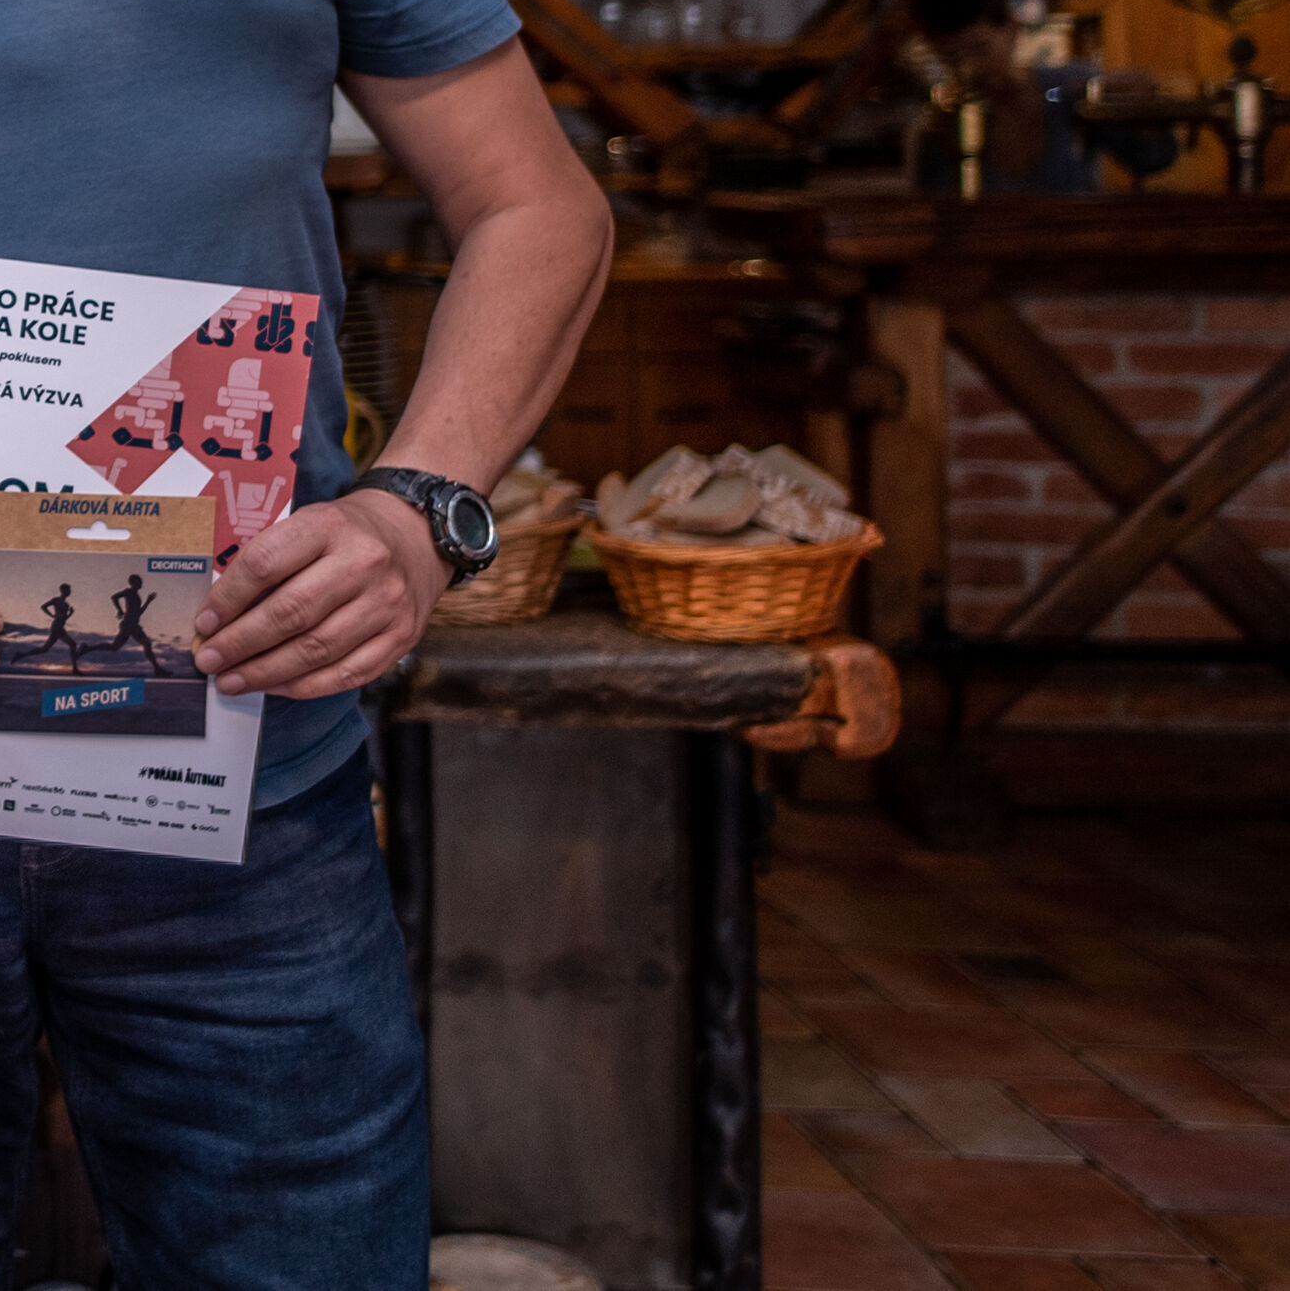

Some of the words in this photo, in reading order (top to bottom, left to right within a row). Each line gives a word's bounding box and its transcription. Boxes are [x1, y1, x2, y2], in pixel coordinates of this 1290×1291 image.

[23, 291, 115, 322] PRÁCE
[19, 318, 87, 345] KOLE
[18, 383, 84, 408] VÝZVA
[39, 497, 109, 515] DÁRKOVÁ
[112, 501, 160, 517] KARTA
[150, 560, 204, 571] DECATHLON
[54, 695, 77, 711] NA
[80, 686, 130, 707] SPORT
